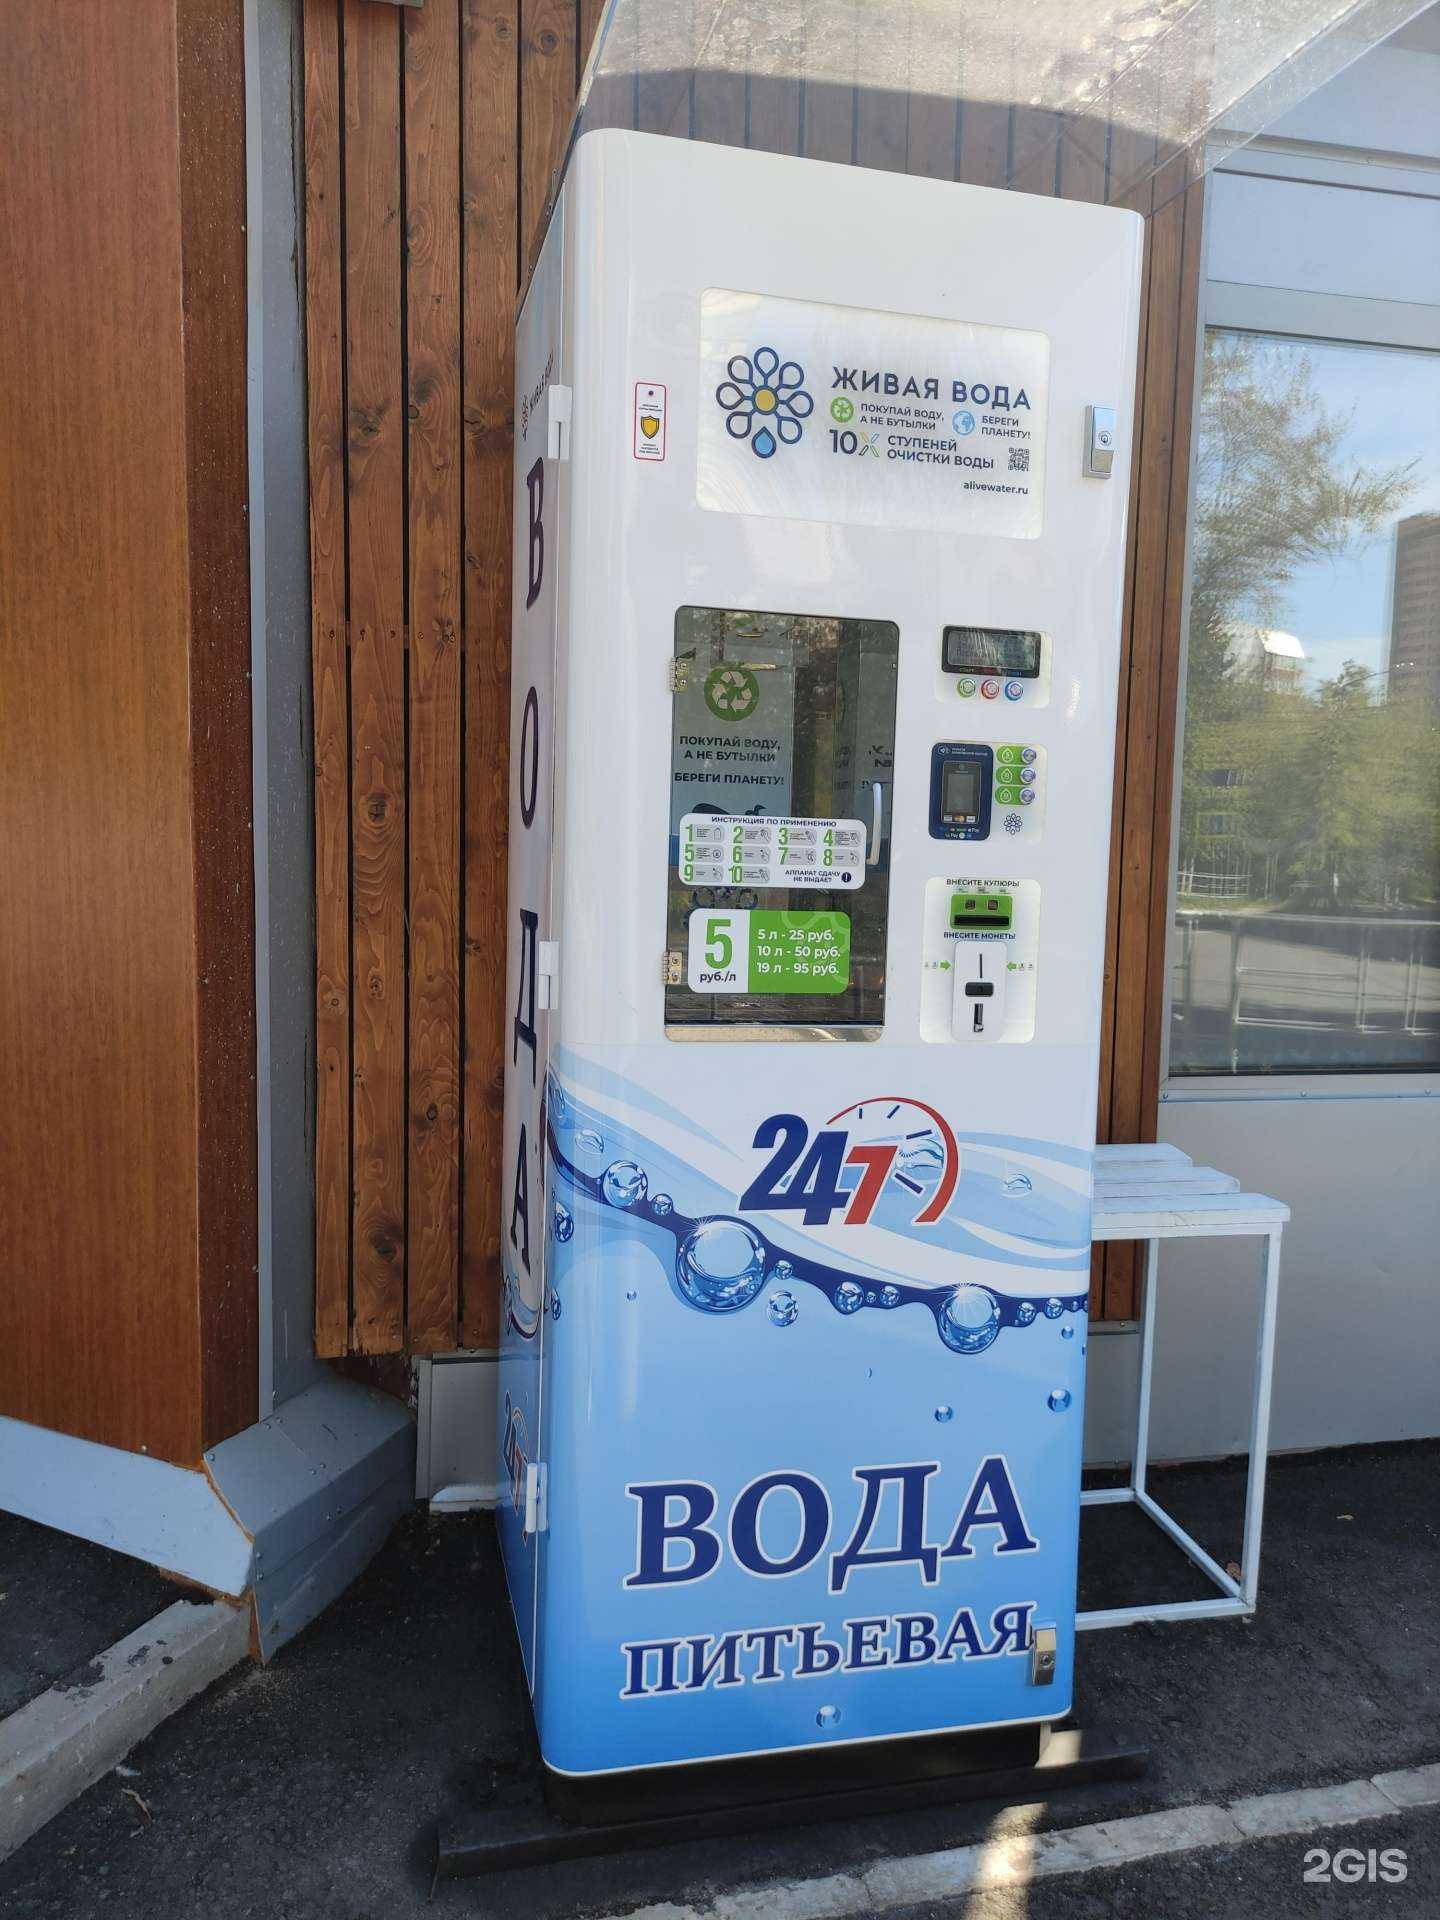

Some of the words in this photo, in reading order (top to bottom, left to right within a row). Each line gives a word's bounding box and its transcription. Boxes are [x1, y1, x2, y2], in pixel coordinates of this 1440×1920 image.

[831, 366, 939, 400] ЖИВАЯ
[952, 380, 1031, 411] ВОДА
[860, 403, 911, 416] ПОКУПАЙ
[914, 409, 945, 422] ВОДУ,
[982, 415, 1019, 427] БЕРЕГИ
[860, 415, 868, 423] А
[870, 416, 884, 425] НЕ
[887, 418, 936, 430] БУТЫЛКИ
[829, 428, 858, 455] 10
[981, 426, 1031, 440] ПЛАНЕТУ!
[888, 434, 957, 452] СТУПЕНЕЙ
[887, 449, 950, 465] ОЧИСТКИ
[954, 455, 994, 470] ВОДЫ
[963, 481, 1029, 495] alivewater.ru
[680, 735, 740, 747] ПОКУПАЙ
[744, 739, 781, 751] ВОДУ,
[684, 750, 693, 759] А
[696, 750, 713, 760] НЕ
[716, 751, 776, 762] БУТЫЛКИ
[674, 772, 720, 783] БЕРЕГИ
[724, 774, 784, 785] ПЛАНЕТУ!
[711, 816, 765, 825] ИНСТРУКЦИЯ
[780, 819, 837, 827] ПРИМЕНЕНИЮ
[685, 824, 693, 842] 1
[733, 825, 743, 844] 2
[778, 827, 788, 845] 3
[823, 829, 833, 847] 4
[685, 844, 694, 862] 5
[733, 845, 742, 863] 6
[778, 847, 788, 865] 7
[823, 848, 833, 867] 8
[684, 864, 694, 881] 9
[728, 865, 743, 883] 10
[946, 878, 982, 886] ВНЕСИТЕ
[704, 918, 733, 970] 5
[757, 929, 766, 940] 5
[768, 932, 778, 940] л
[789, 930, 804, 940] 25
[807, 930, 835, 943] руб.
[943, 931, 980, 939] ВНЕСИТЕ
[981, 932, 1016, 940] МОНЕТЫ
[757, 945, 771, 956] 10
[774, 948, 783, 957] л
[794, 946, 810, 957] 50
[814, 946, 841, 959] руб.
[699, 971, 737, 983] руб./л
[757, 962, 770, 973] 19
[773, 965, 782, 973] л
[793, 963, 809, 974] 95
[812, 962, 839, 976] руб.
[624, 1456, 1038, 1593] ВОДА
[622, 1603, 1038, 1697] ПИТЬЕВАЯ
